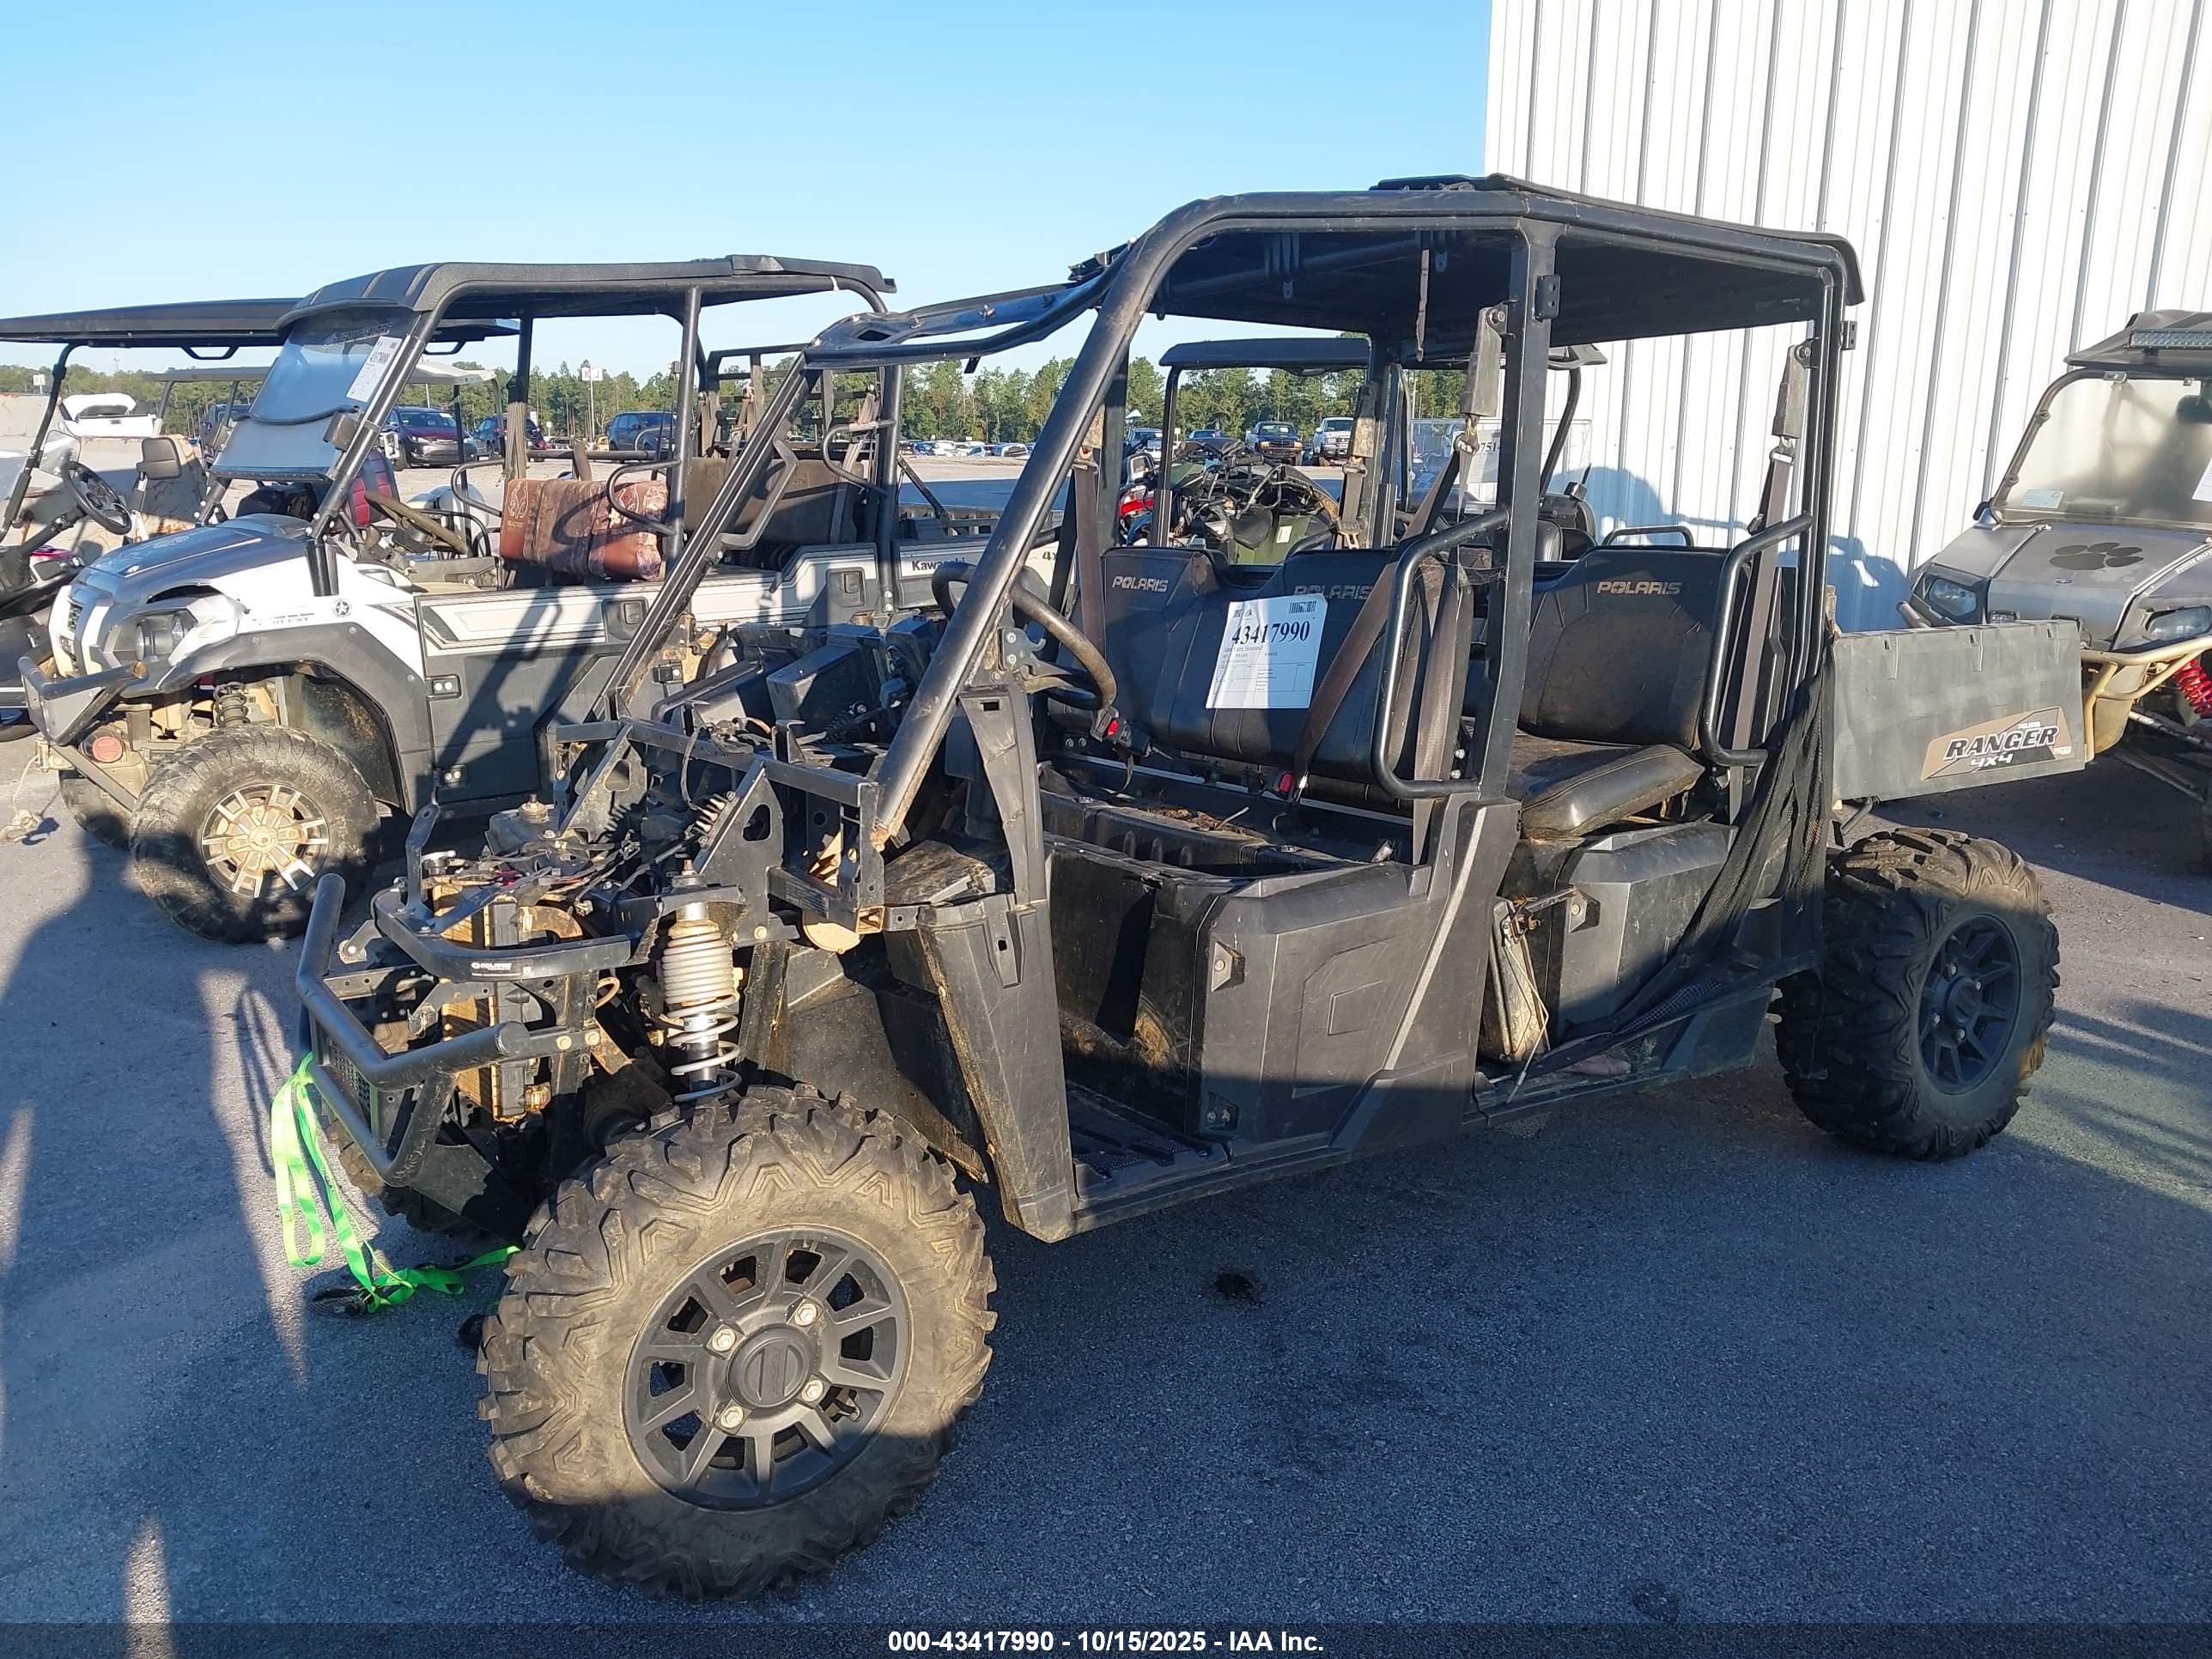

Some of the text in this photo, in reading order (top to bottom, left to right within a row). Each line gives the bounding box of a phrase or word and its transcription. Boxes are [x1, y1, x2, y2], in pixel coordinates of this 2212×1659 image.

[1112, 575, 1168, 592] POLARIS
[1597, 581, 1682, 595] POLARIS
[1231, 620, 1310, 645] 43417990
[1943, 725, 2060, 761] RANGER
